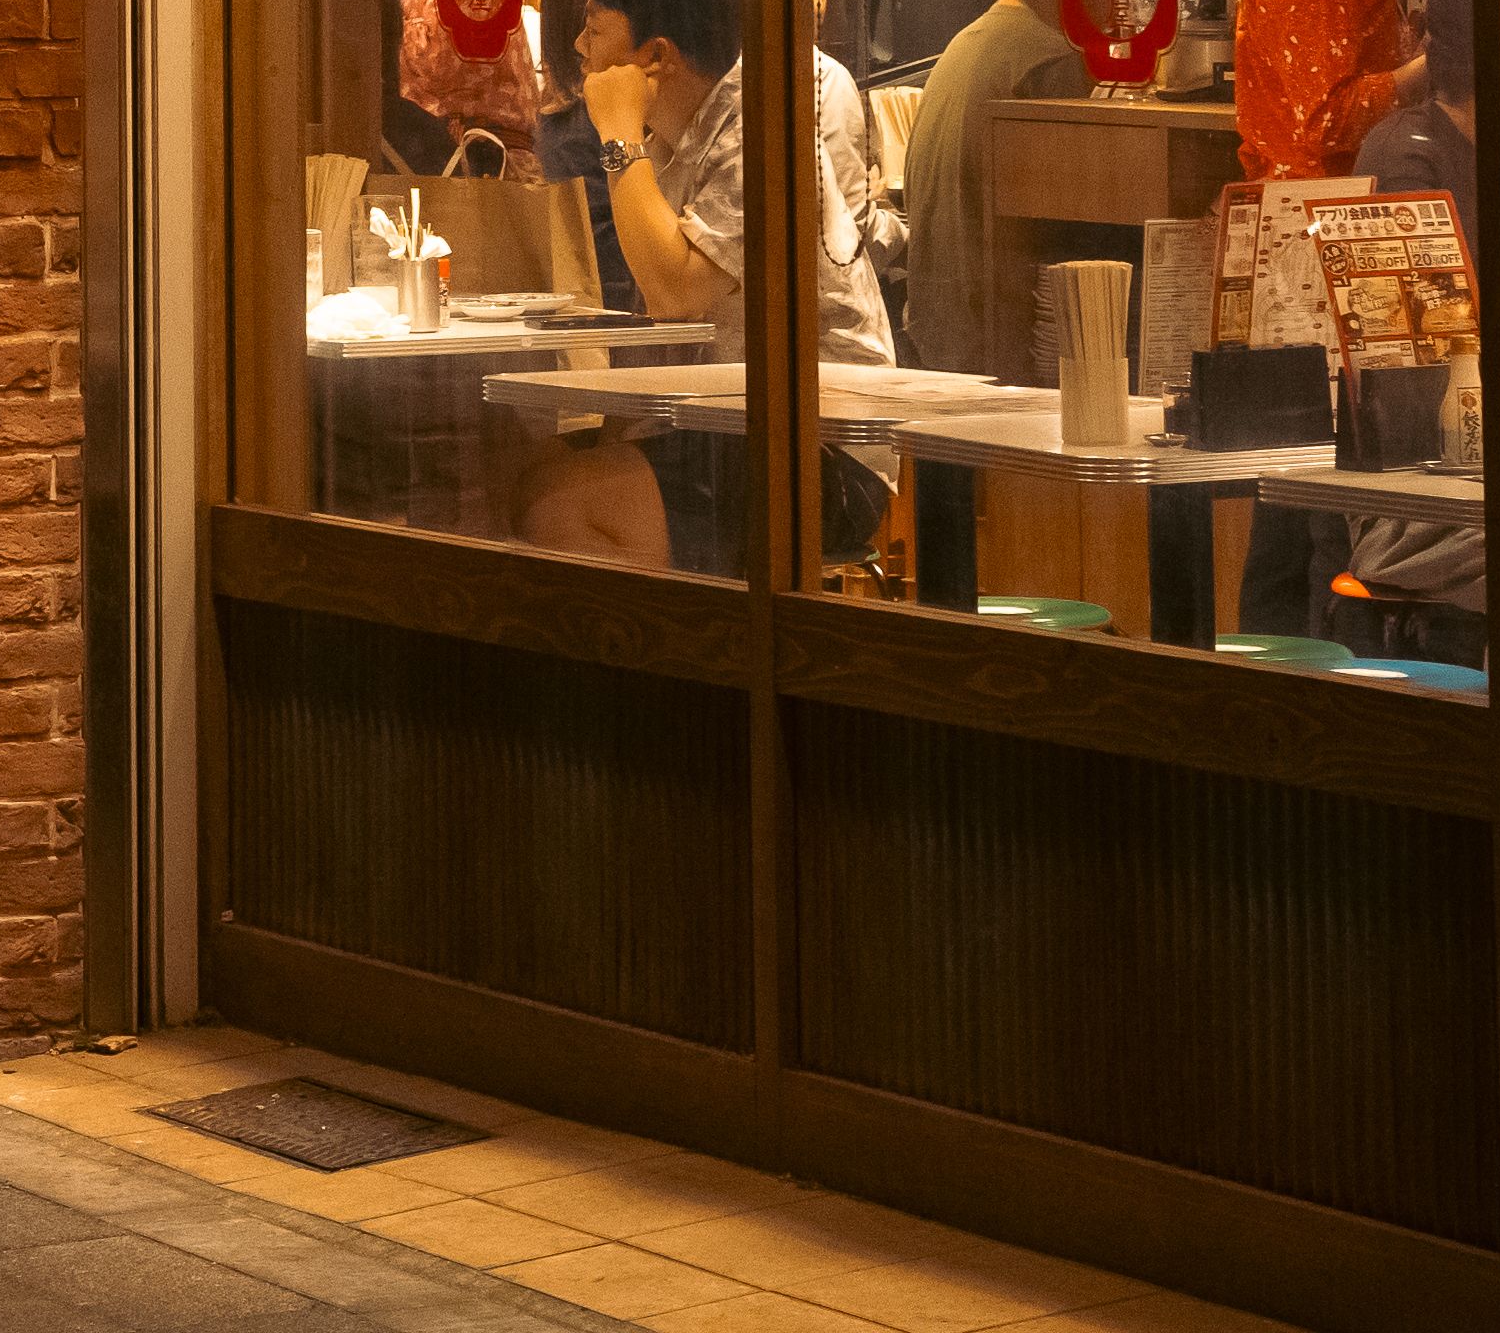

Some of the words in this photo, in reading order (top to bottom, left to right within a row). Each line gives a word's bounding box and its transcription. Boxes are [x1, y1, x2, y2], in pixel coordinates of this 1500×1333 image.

[1315, 205, 1393, 222] アプリ会員募集
